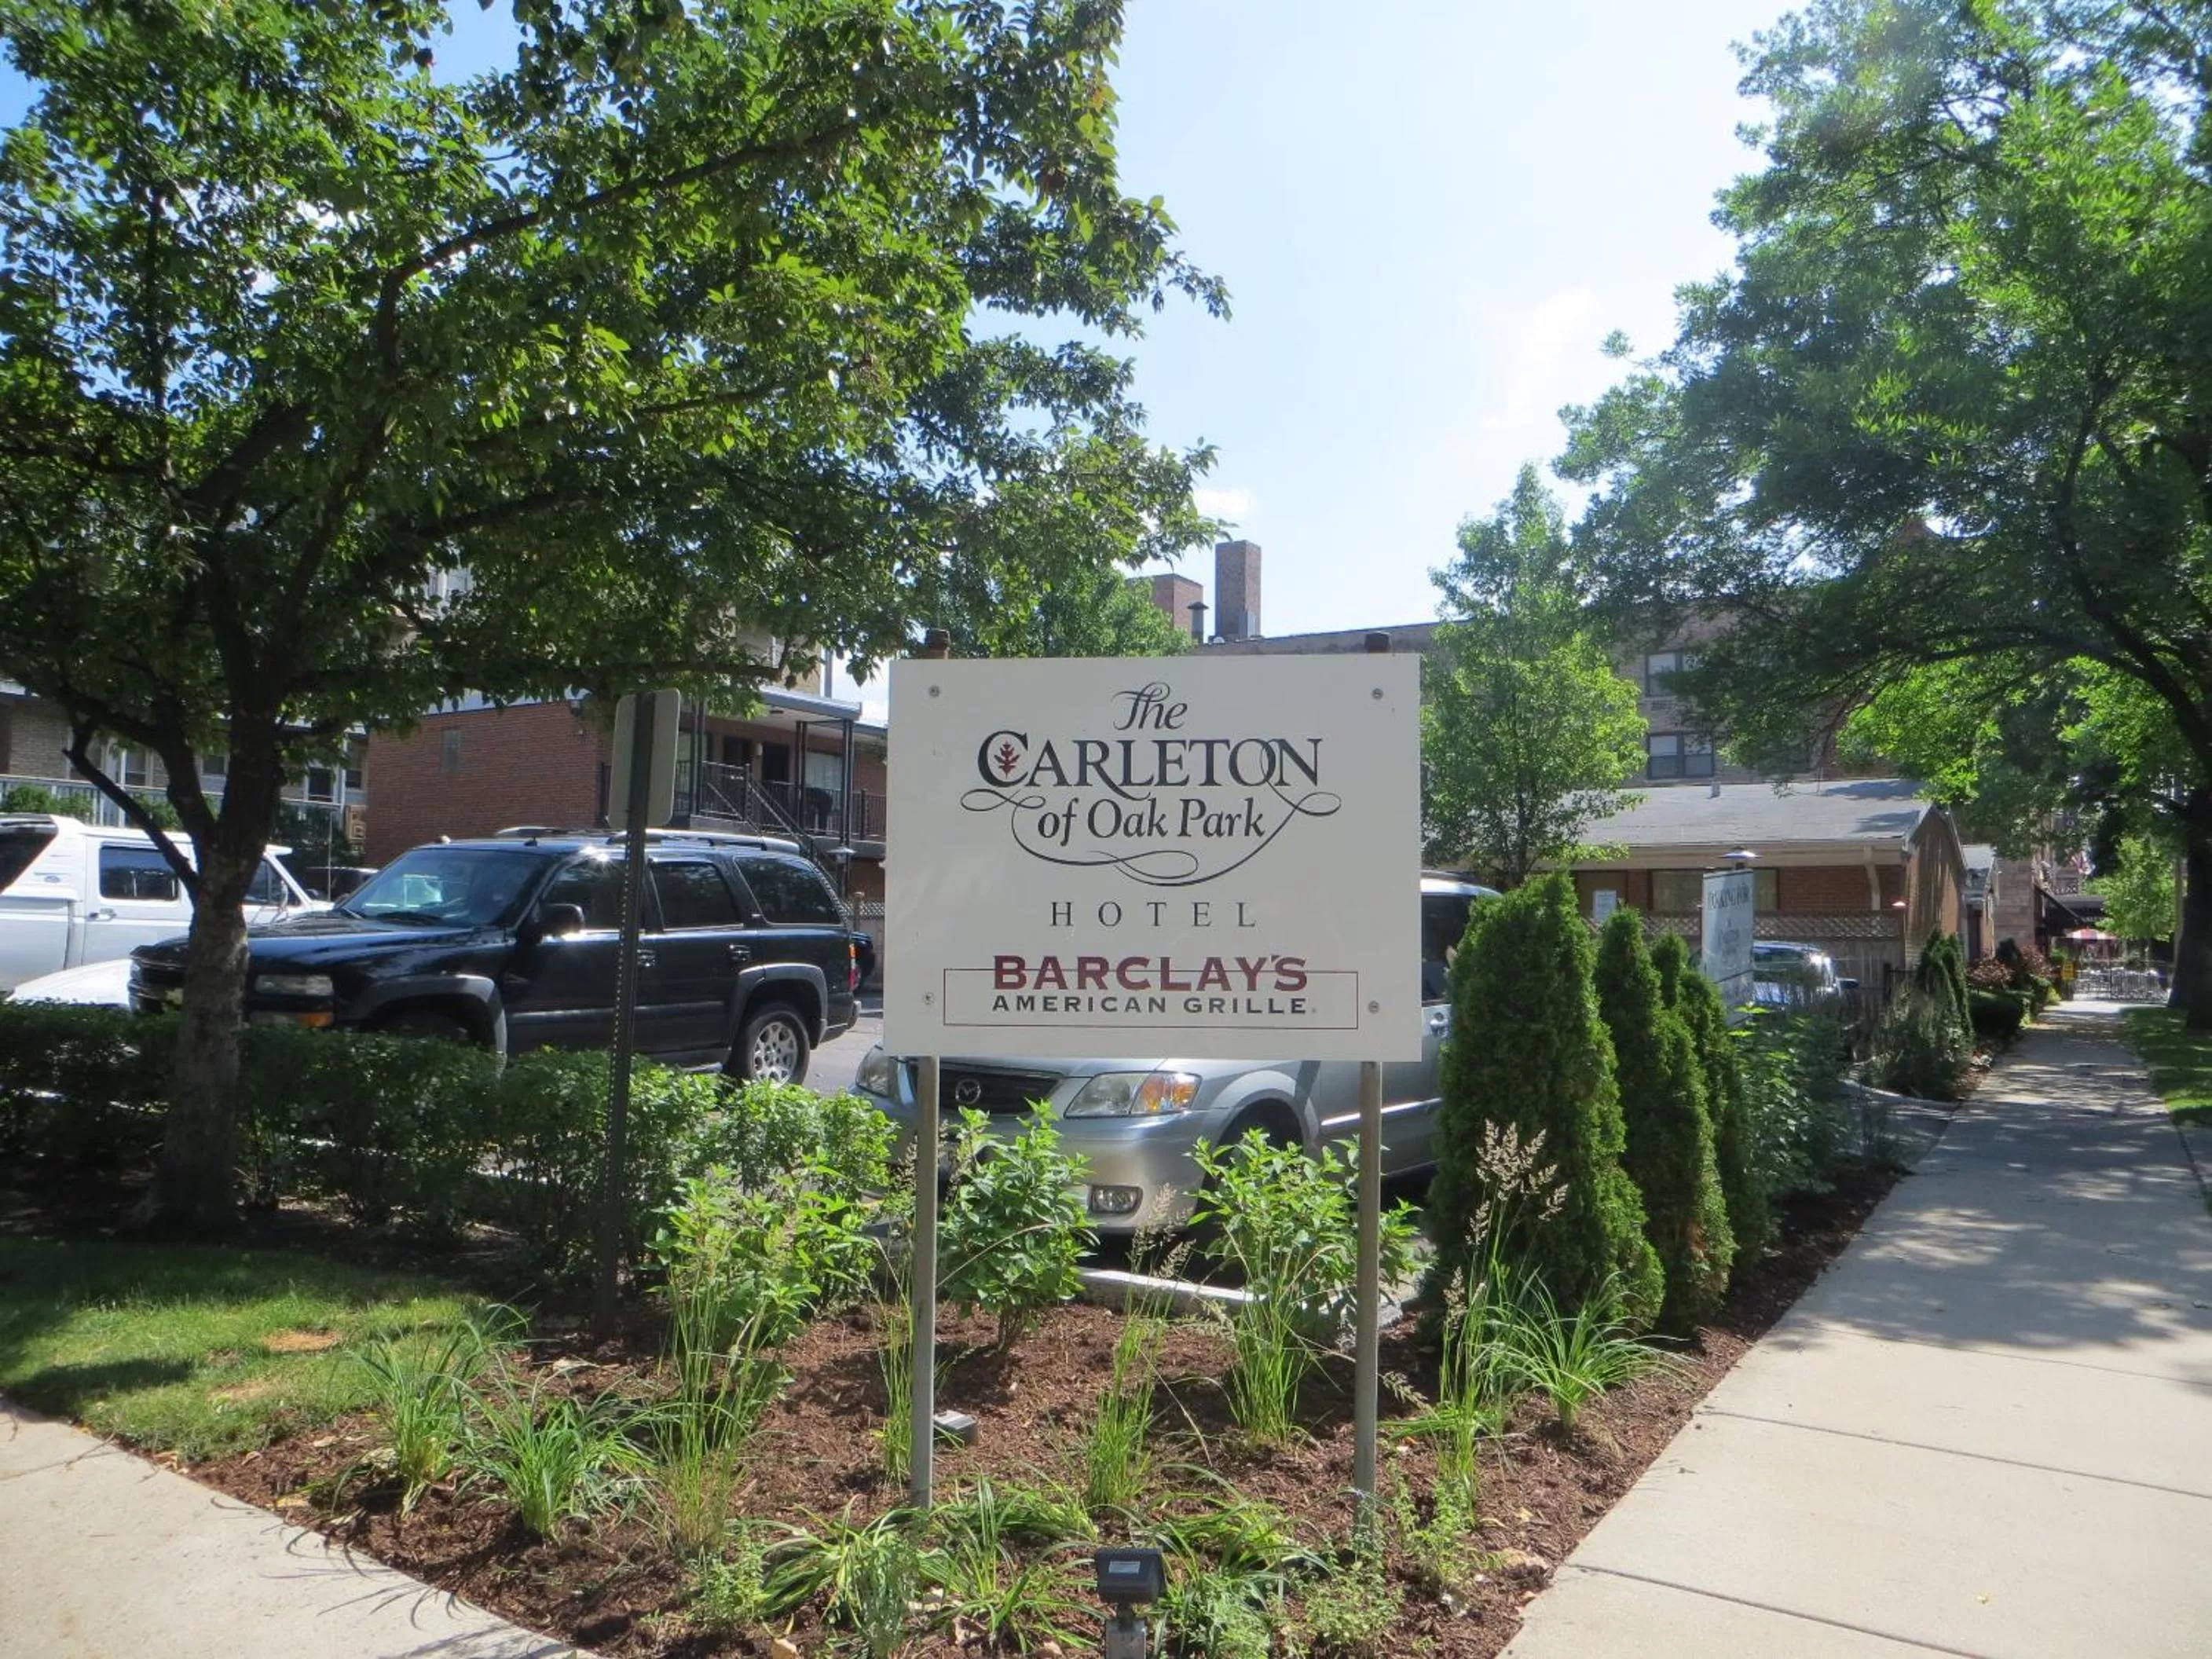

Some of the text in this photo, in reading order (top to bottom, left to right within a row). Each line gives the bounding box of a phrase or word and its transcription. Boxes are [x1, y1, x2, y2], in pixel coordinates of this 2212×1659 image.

[1111, 682, 1188, 731] The
[977, 730, 1324, 801] CARLETON
[1037, 797, 1265, 847] of Oak Park
[1049, 901, 1258, 928] HOTEL
[993, 954, 1309, 993] BARCLAY'S
[991, 994, 1307, 1014] AMERICAN GRILLE
